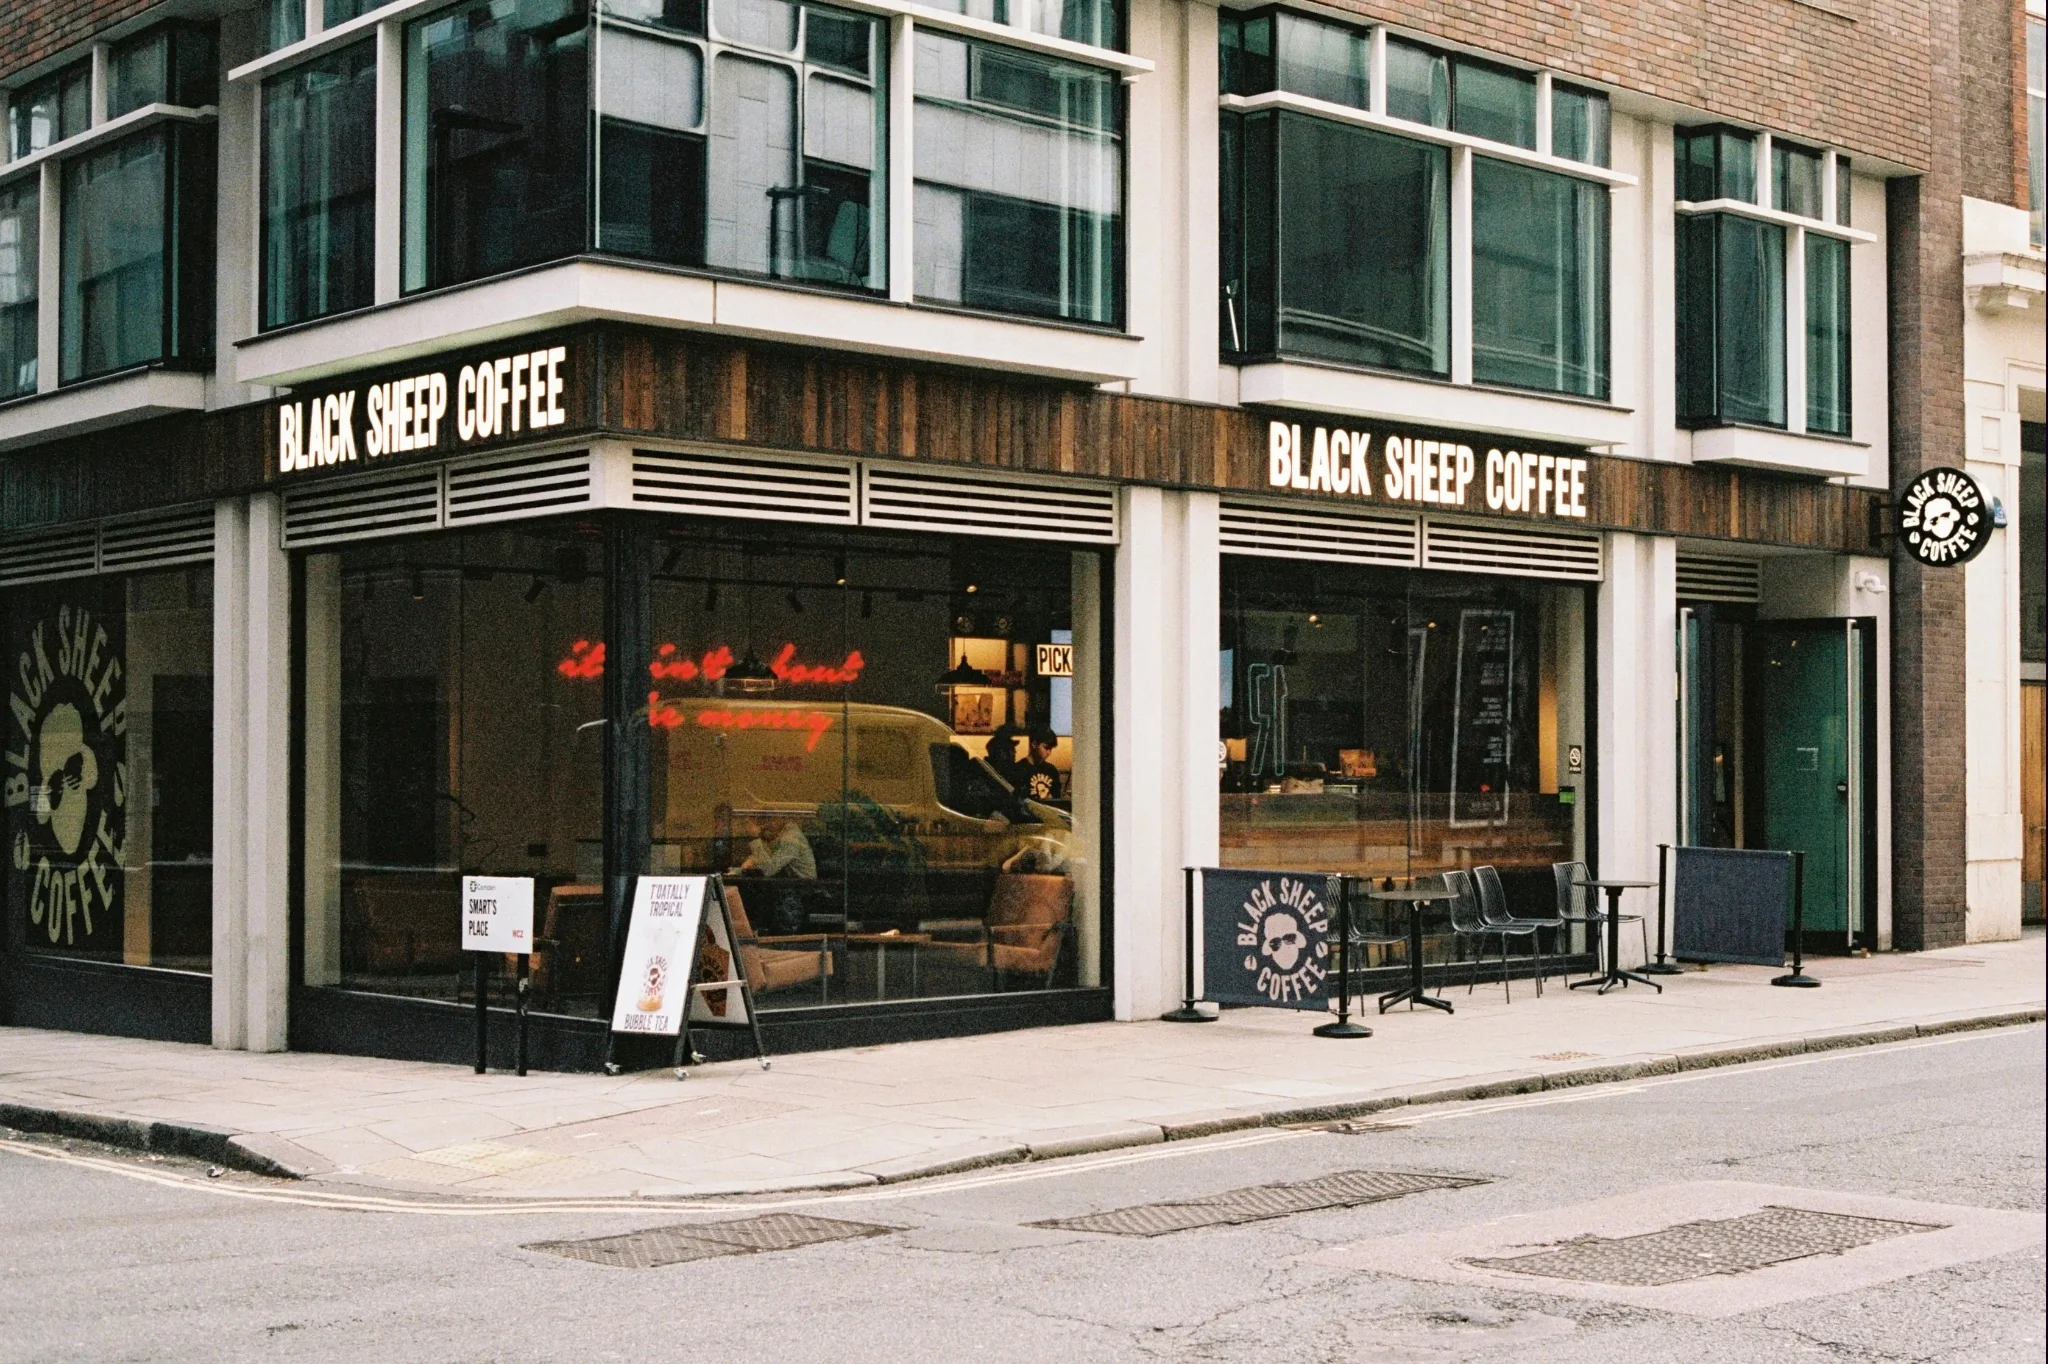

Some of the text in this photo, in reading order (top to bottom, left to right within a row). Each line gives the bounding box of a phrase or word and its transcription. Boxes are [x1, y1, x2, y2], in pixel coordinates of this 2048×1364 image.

[279, 346, 566, 473] BLACK SHEEP COFFEE
[1269, 421, 1587, 518] BLACK SHEEP COFFEE
[1902, 472, 1979, 528] BLACK SHEEP
[1919, 524, 1978, 561] COFFEE
[1038, 646, 1072, 673] PICK
[4, 603, 127, 807] BLACK SHEEP
[696, 710, 834, 752] money
[30, 807, 126, 946] COFFEE
[468, 898, 498, 916] SMART'S
[649, 901, 684, 917] TROPICAL
[1237, 877, 1328, 946] BLACK SHEEP
[468, 920, 489, 937] PLACE
[512, 929, 524, 939] WC2
[1256, 956, 1327, 1003] COFFEE
[623, 1013, 669, 1032] BUBBLE TEA
